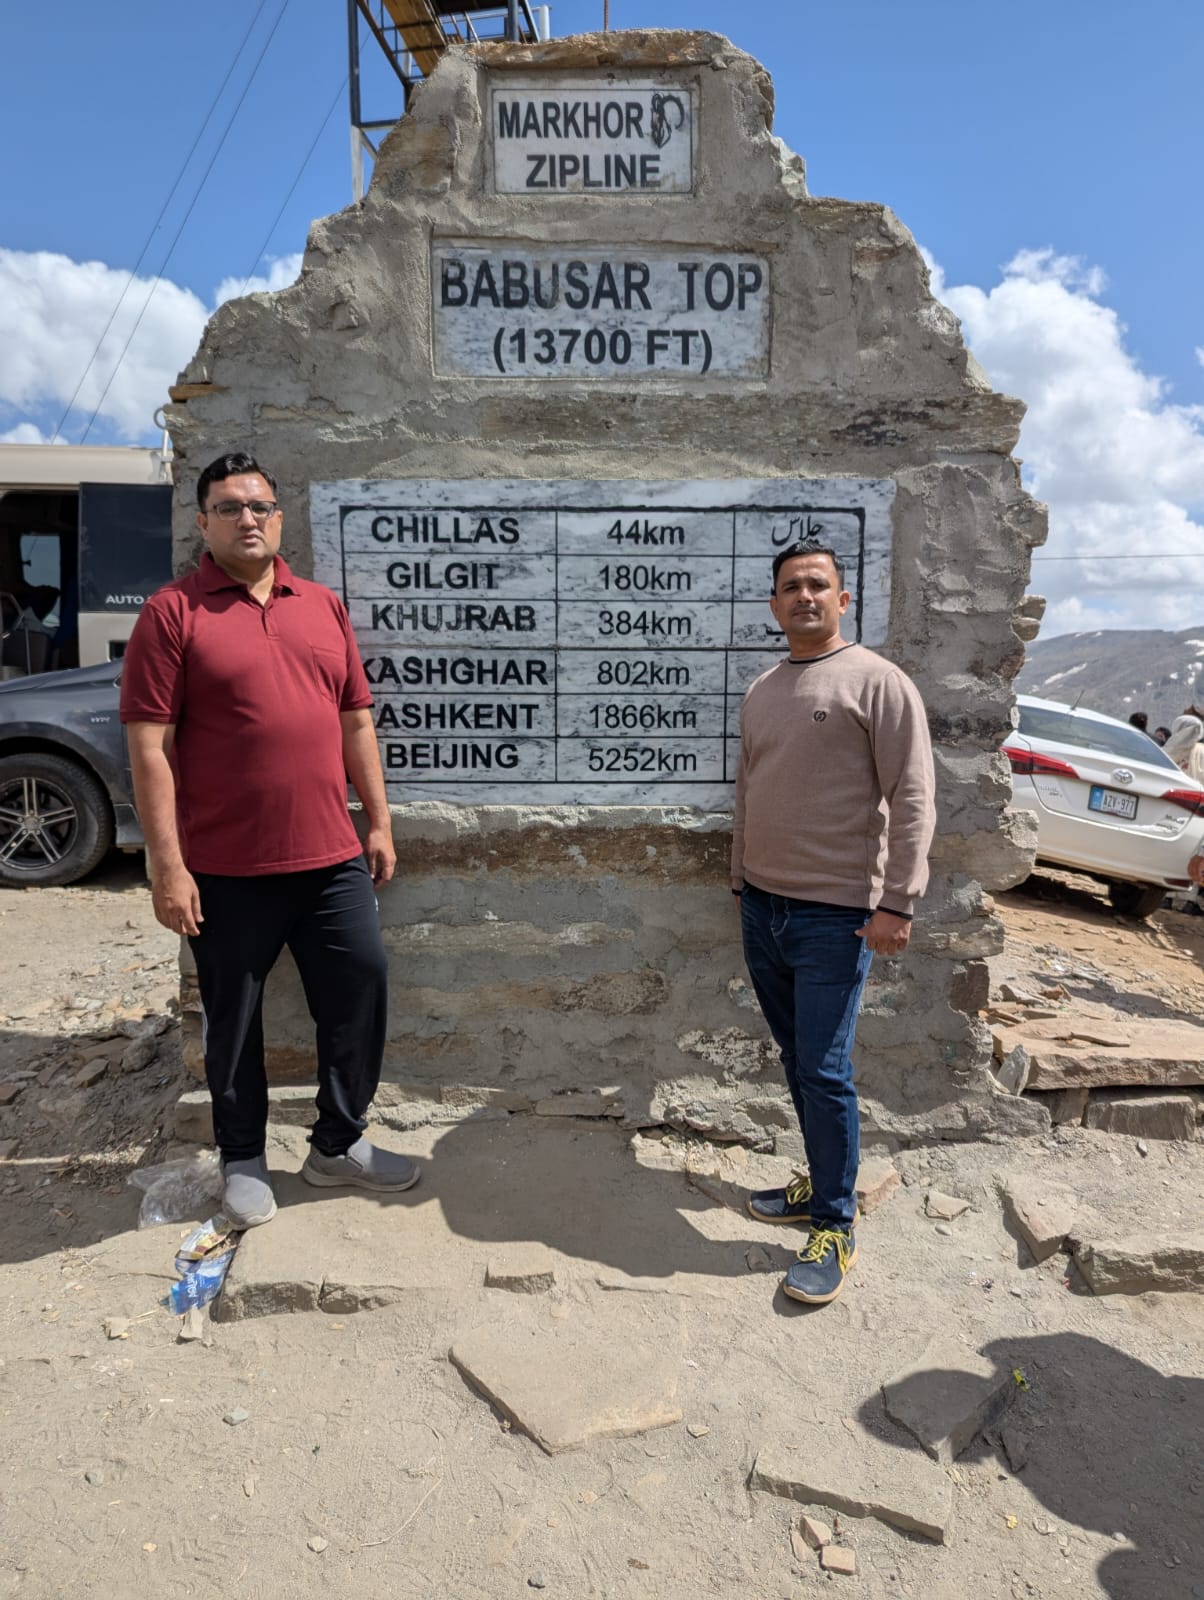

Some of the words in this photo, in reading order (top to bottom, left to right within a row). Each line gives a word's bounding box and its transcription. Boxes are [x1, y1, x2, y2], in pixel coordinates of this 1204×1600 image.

[499, 101, 644, 139] MARKHOR
[526, 154, 661, 188] ZIPLINE
[440, 258, 652, 311] BABUSAR
[678, 262, 763, 311] TOP
[493, 327, 632, 373] (13700
[646, 329, 713, 374] FT)
[371, 515, 520, 545] CHILLAS
[607, 519, 685, 545] 44km
[386, 562, 500, 590] GILGIT
[600, 565, 692, 591] 180km
[105, 594, 145, 605] AUTO
[372, 604, 536, 632] KHUJRAB
[598, 610, 692, 636] 384km
[597, 660, 690, 686] 802km
[368, 703, 540, 730] ASHKENT
[589, 704, 697, 730] 1866km
[386, 743, 519, 769] BEIJING
[588, 748, 697, 772] 5252km
